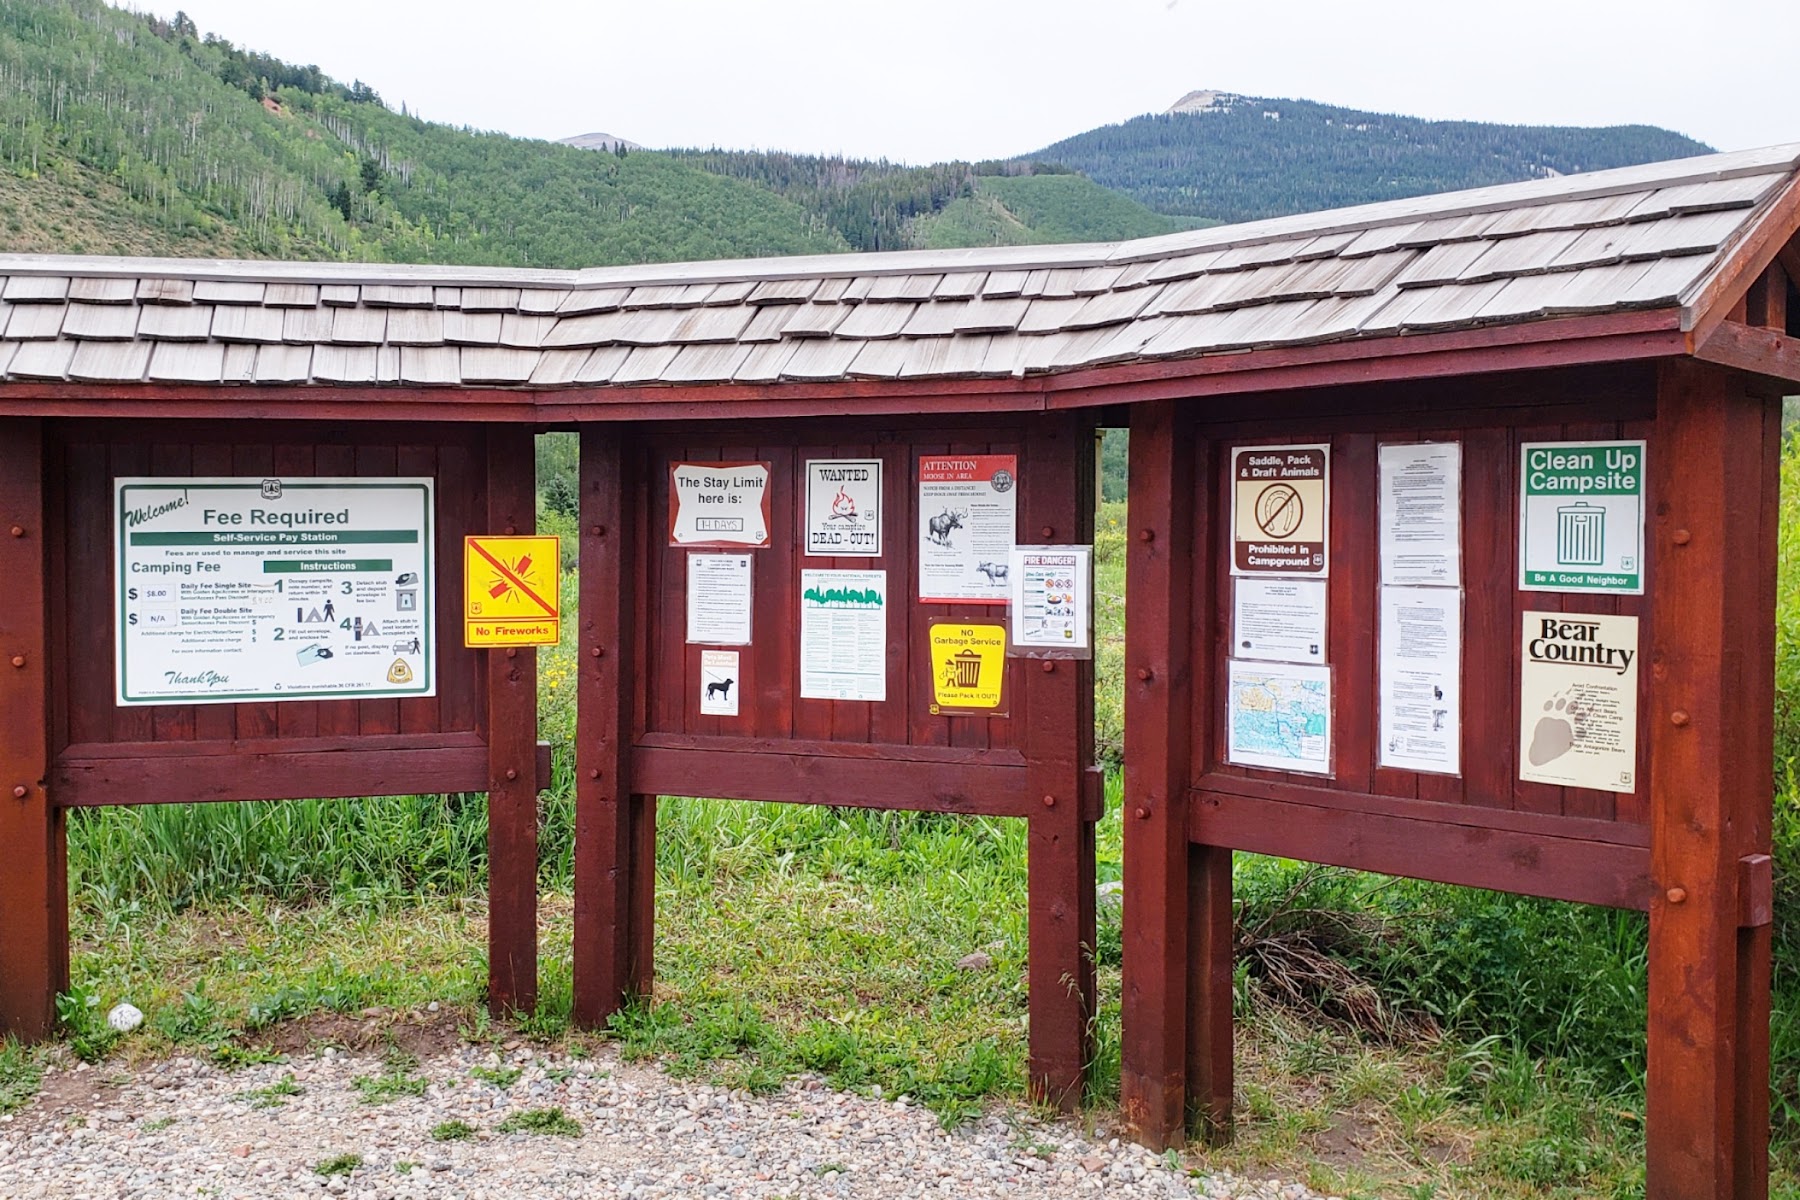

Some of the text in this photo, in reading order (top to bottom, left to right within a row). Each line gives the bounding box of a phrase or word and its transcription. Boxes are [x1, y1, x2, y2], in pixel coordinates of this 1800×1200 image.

[924, 461, 977, 470] ATTENTION
[1249, 455, 1311, 466] Saddle, Pack
[1530, 450, 1636, 472] Clean Up
[820, 470, 868, 481] WANTED
[1241, 467, 1319, 477] & Draft Animals
[678, 477, 763, 490] The Stay Limit
[1530, 472, 1635, 493] Campsite
[698, 493, 742, 503] here is:
[125, 489, 189, 527] Welcome!
[204, 509, 349, 528] Fee Required
[213, 533, 338, 542] Self-Service Pay Station
[1248, 544, 1309, 554] Prohibited in
[300, 562, 356, 571] Instructions
[1025, 556, 1075, 565] FIRE DANGER!
[1248, 556, 1310, 567] Campground
[131, 561, 221, 575] Camping Fee
[274, 579, 283, 593] 1
[1535, 574, 1546, 582] Be
[1559, 574, 1583, 583] Good
[1587, 575, 1627, 586] Neighbor
[128, 588, 138, 600] $
[341, 581, 353, 595] 3
[129, 613, 138, 625] $
[340, 617, 352, 631] 4
[273, 628, 284, 641] 2
[476, 626, 548, 636] No Fireworks
[1541, 619, 1600, 642] Bear
[934, 637, 968, 646] Garbage
[1529, 639, 1635, 675] Country
